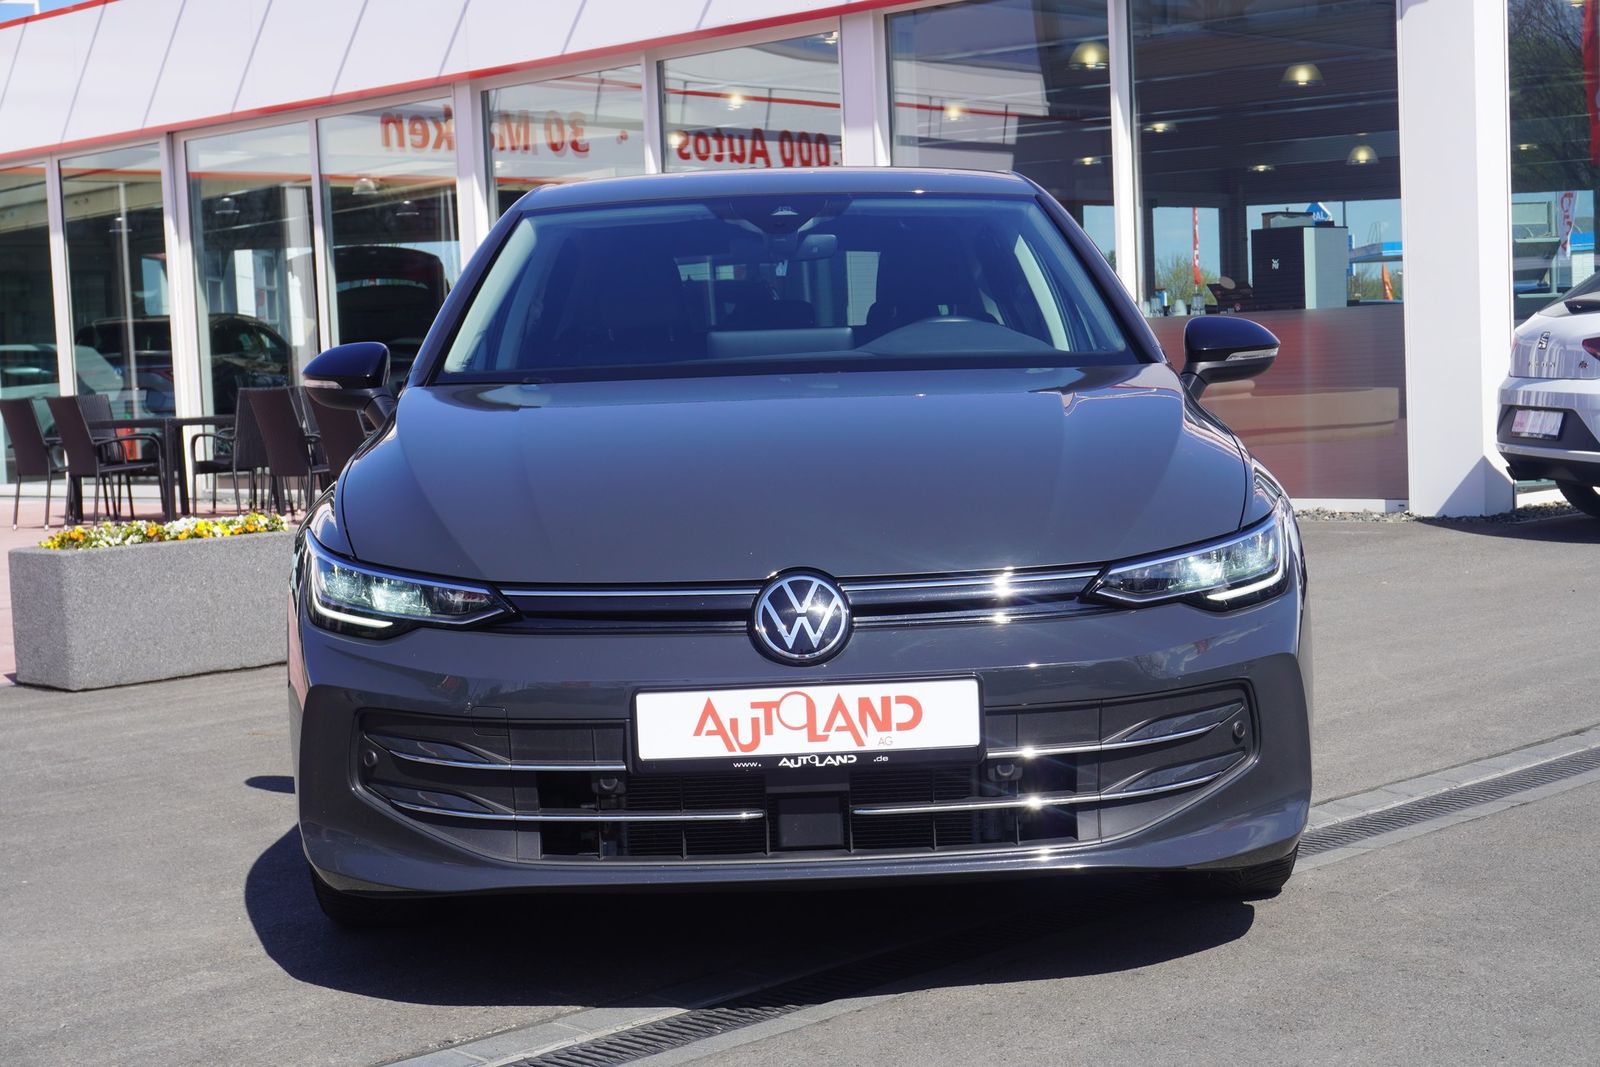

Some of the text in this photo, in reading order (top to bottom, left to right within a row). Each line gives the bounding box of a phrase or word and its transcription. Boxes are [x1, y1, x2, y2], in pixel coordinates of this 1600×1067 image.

[693, 690, 923, 753] AUTOLAND
[877, 736, 893, 746] AG
[778, 754, 857, 769] AUTOLAND
[873, 754, 889, 762] .de
